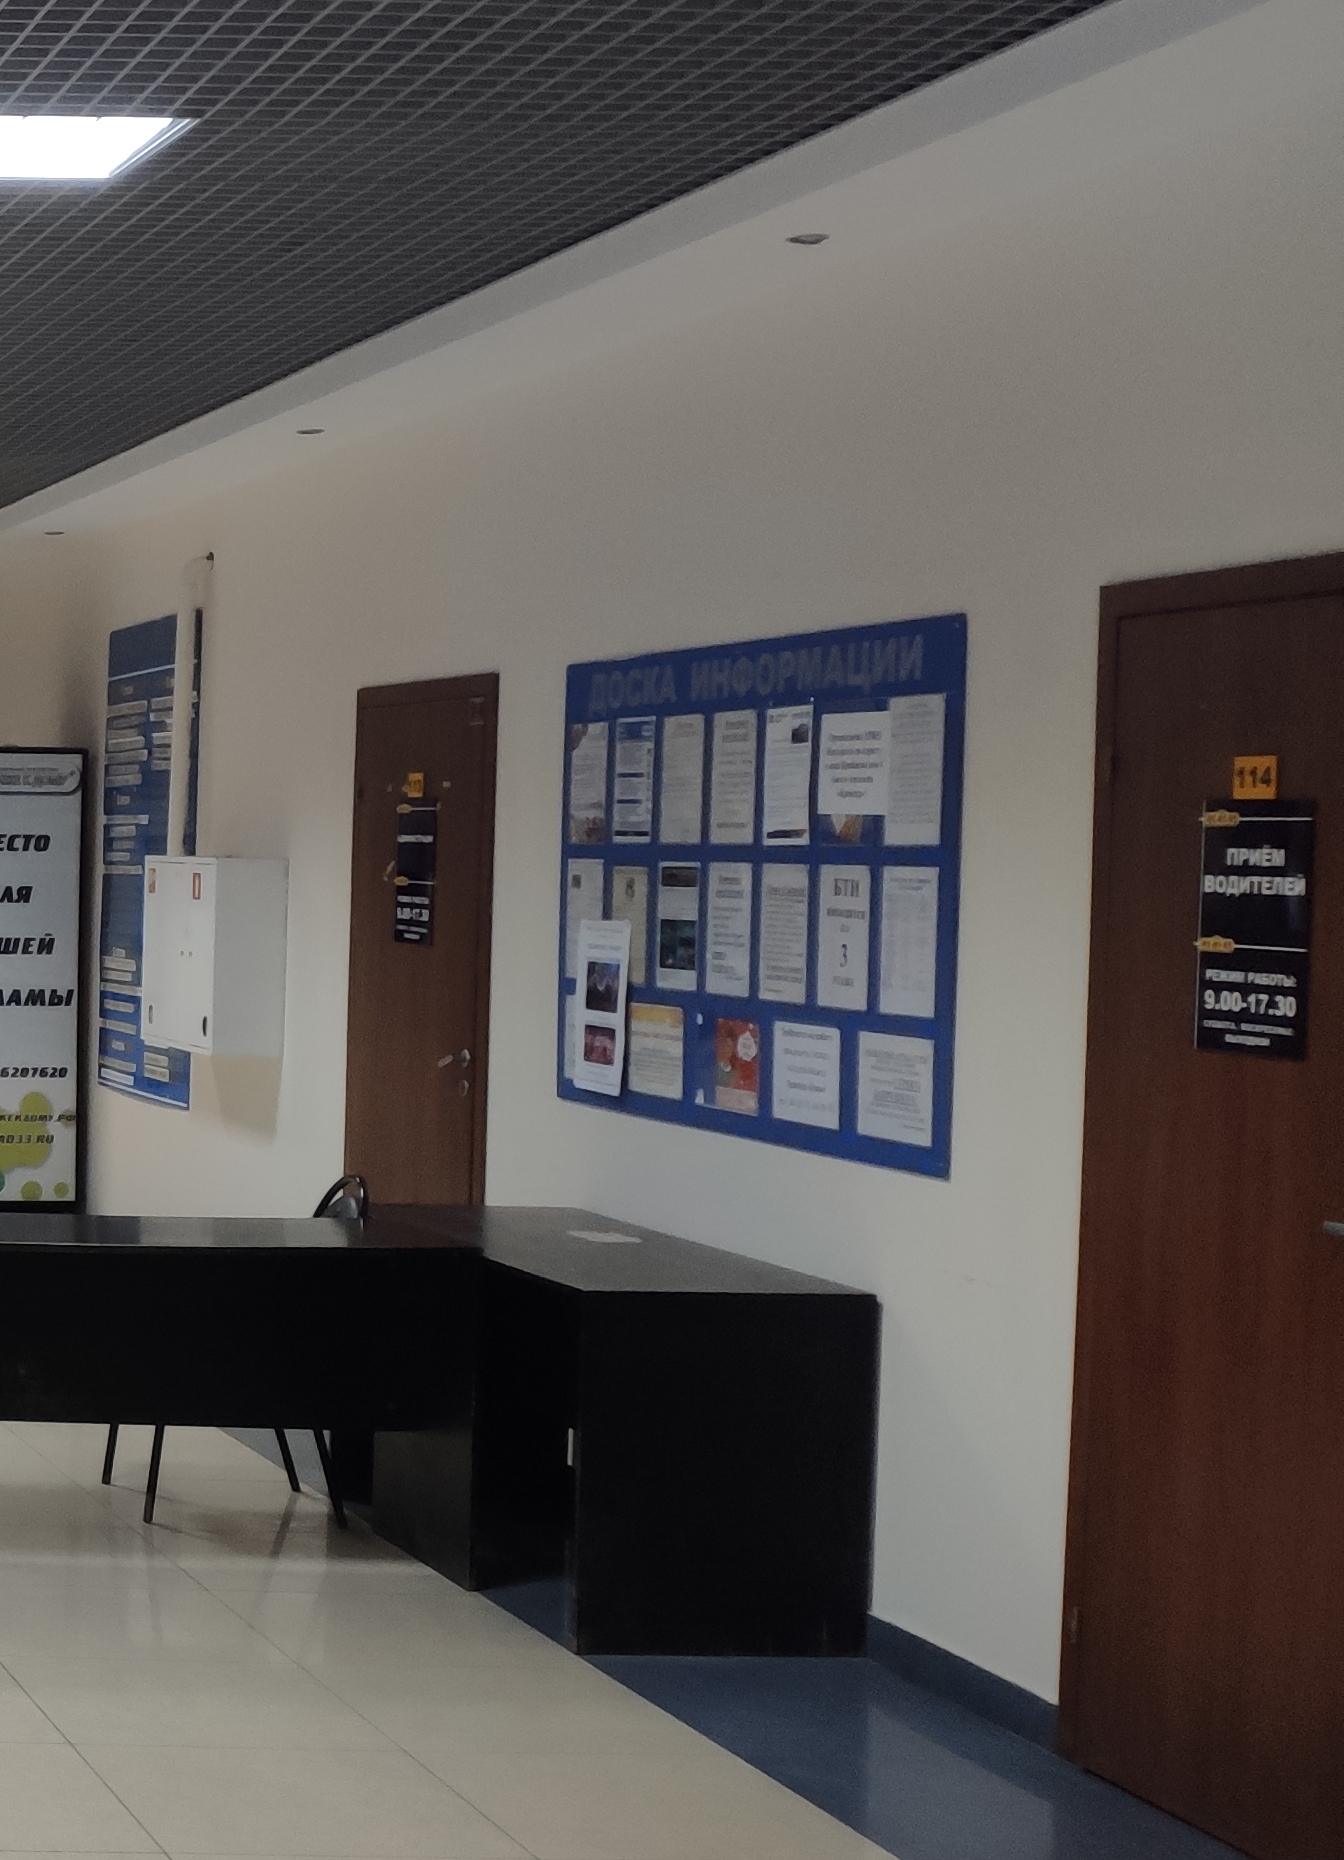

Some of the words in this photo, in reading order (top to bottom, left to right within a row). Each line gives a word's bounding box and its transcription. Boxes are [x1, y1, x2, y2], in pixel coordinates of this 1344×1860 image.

[588, 665, 677, 719] ДОСКА
[690, 634, 925, 697] ИНФОРМАЦИИ
[1236, 765, 1273, 789] 114
[1226, 844, 1286, 867] ПРИЁМ
[833, 878, 860, 898] БТИ
[1203, 873, 1307, 897] ВОДИТЕЛЕЙ
[839, 943, 849, 968] 3
[1203, 989, 1298, 1018] 9.00-17.30
